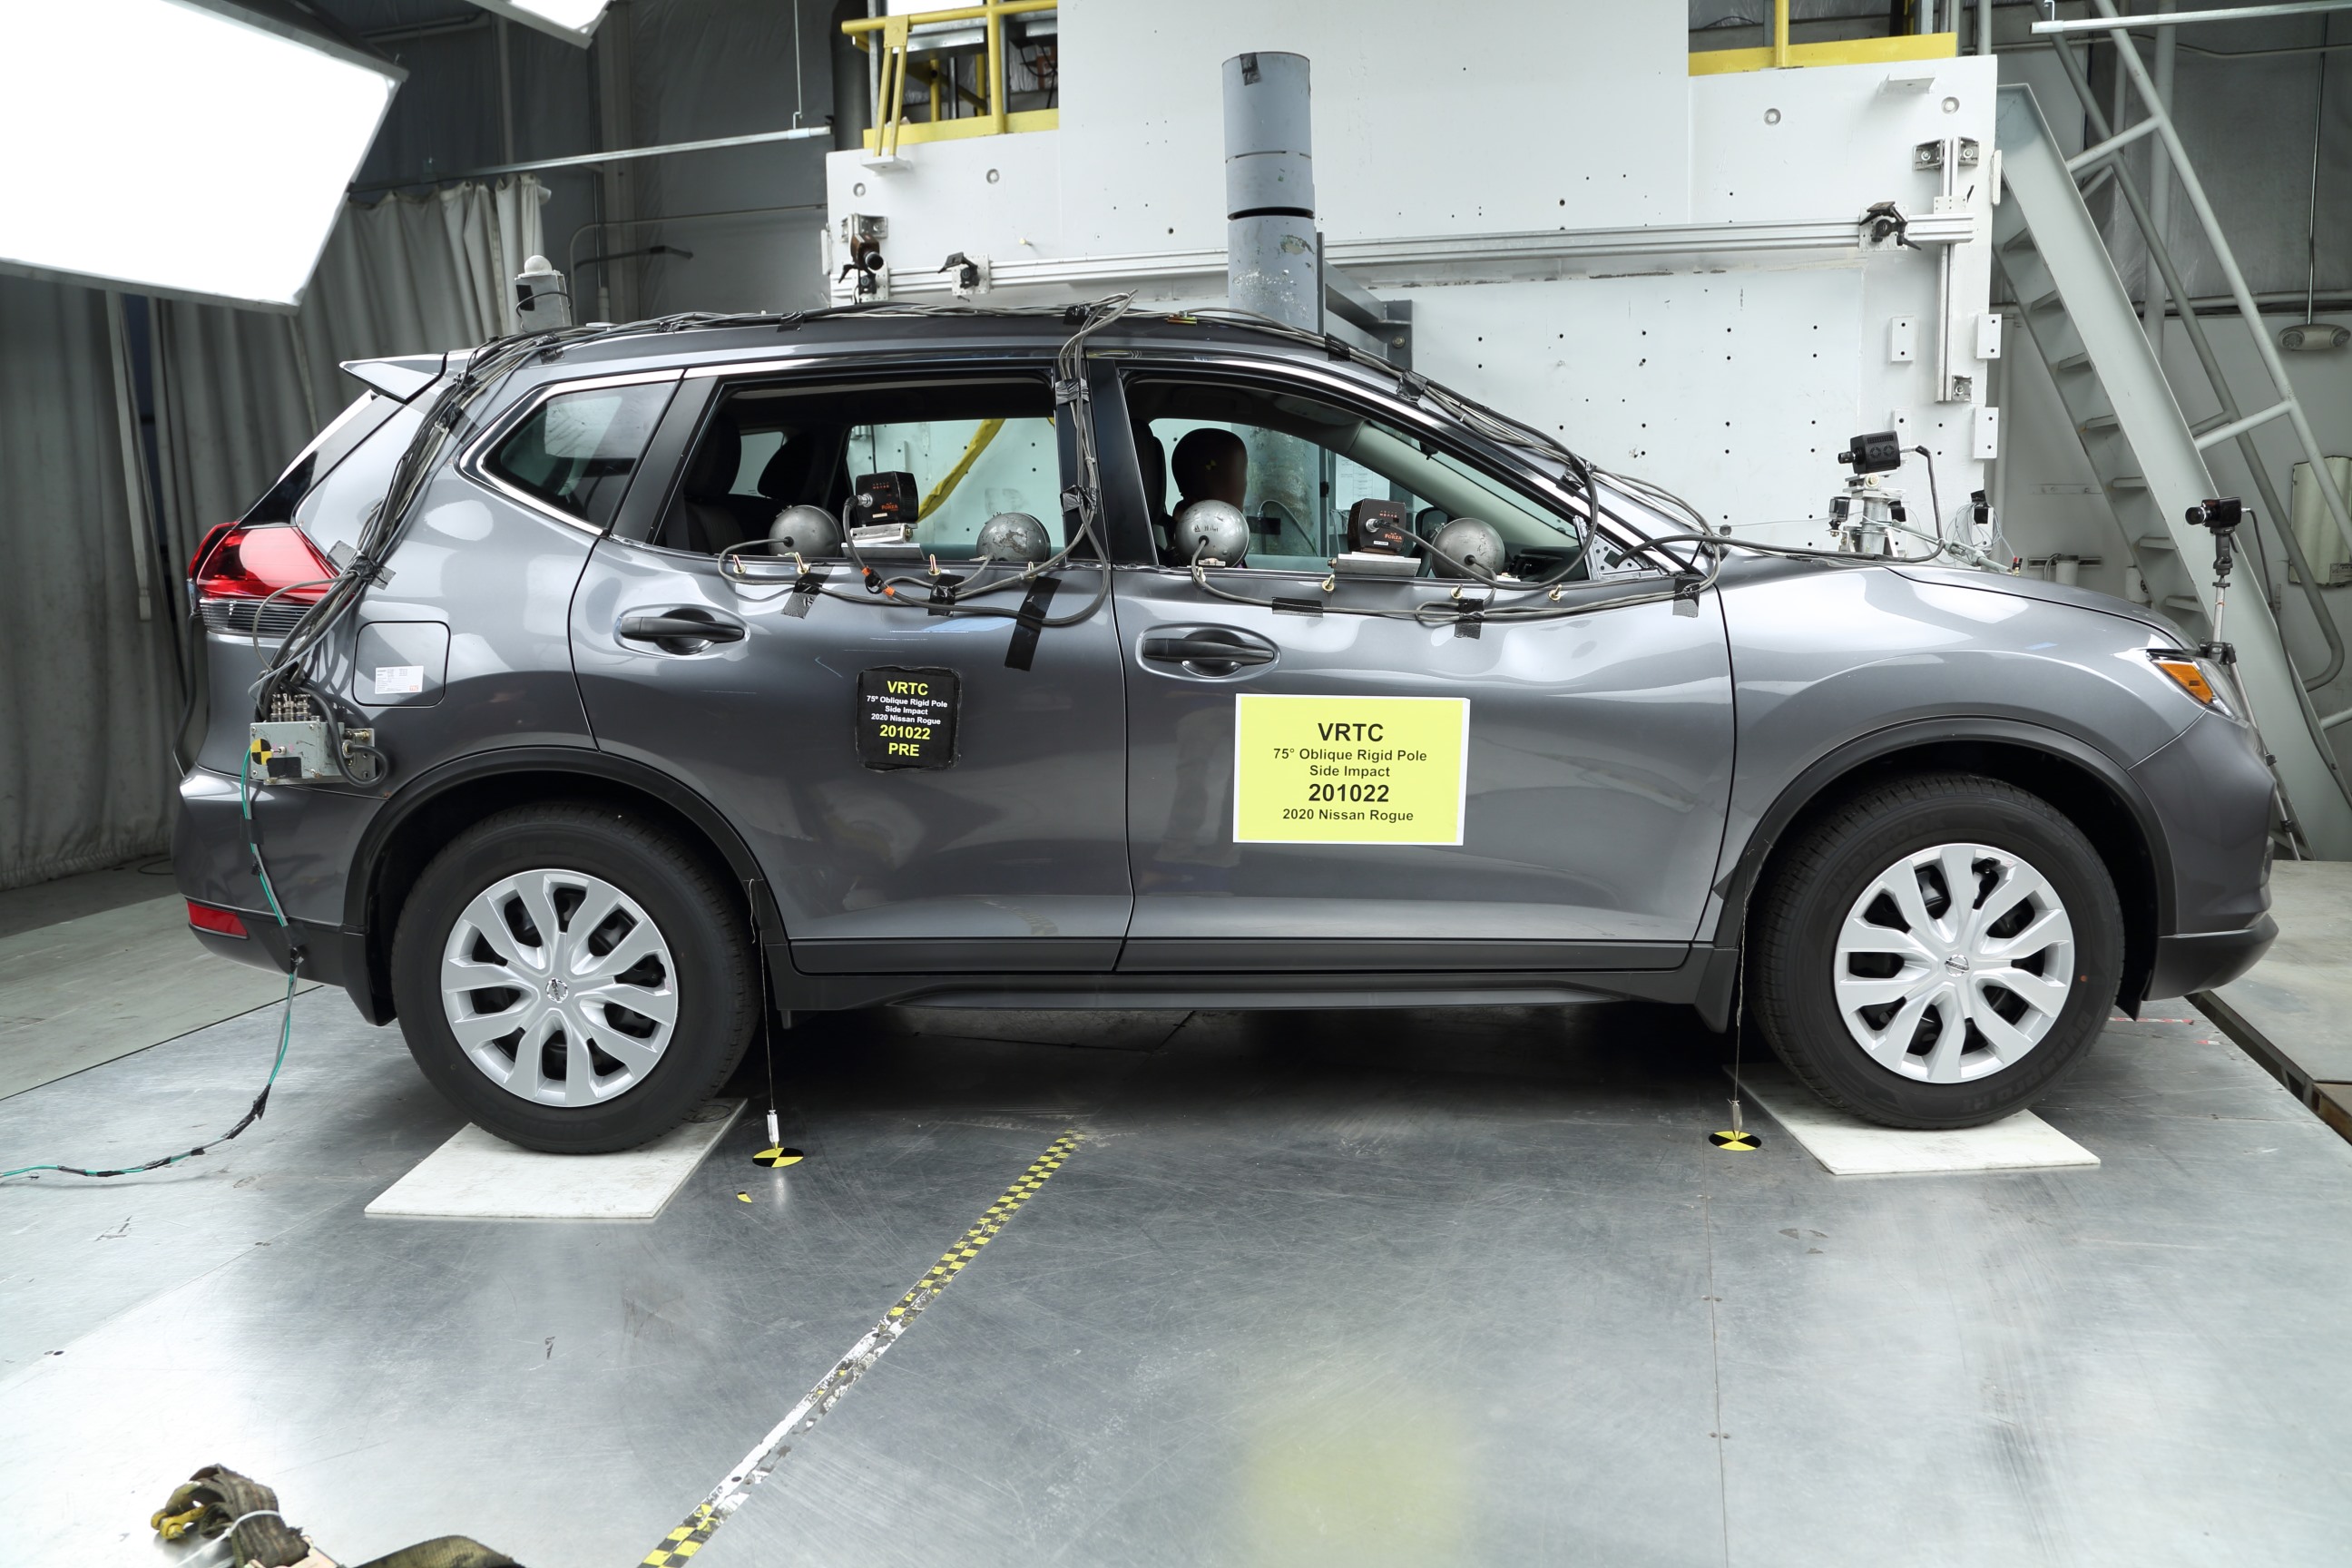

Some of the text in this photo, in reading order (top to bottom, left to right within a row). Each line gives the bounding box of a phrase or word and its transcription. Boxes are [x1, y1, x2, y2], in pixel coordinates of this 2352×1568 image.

[887, 681, 929, 696] VRTC
[879, 696, 908, 706] Oblique
[910, 698, 930, 708] Rigid
[931, 700, 948, 708] Pole
[885, 705, 928, 716] Side Impact
[871, 713, 941, 726] 2020 Nissan Rogue
[879, 724, 931, 740] 201022
[1318, 722, 1384, 742] VRTC
[888, 742, 920, 757] PRE
[1299, 748, 1353, 762] Oblique
[1357, 749, 1393, 764] Rigid
[1397, 750, 1427, 761] Pole
[1309, 764, 1390, 779] Side Impact
[1308, 783, 1389, 803] 201022
[1282, 808, 1414, 824] 2020 Nissan Rogue
